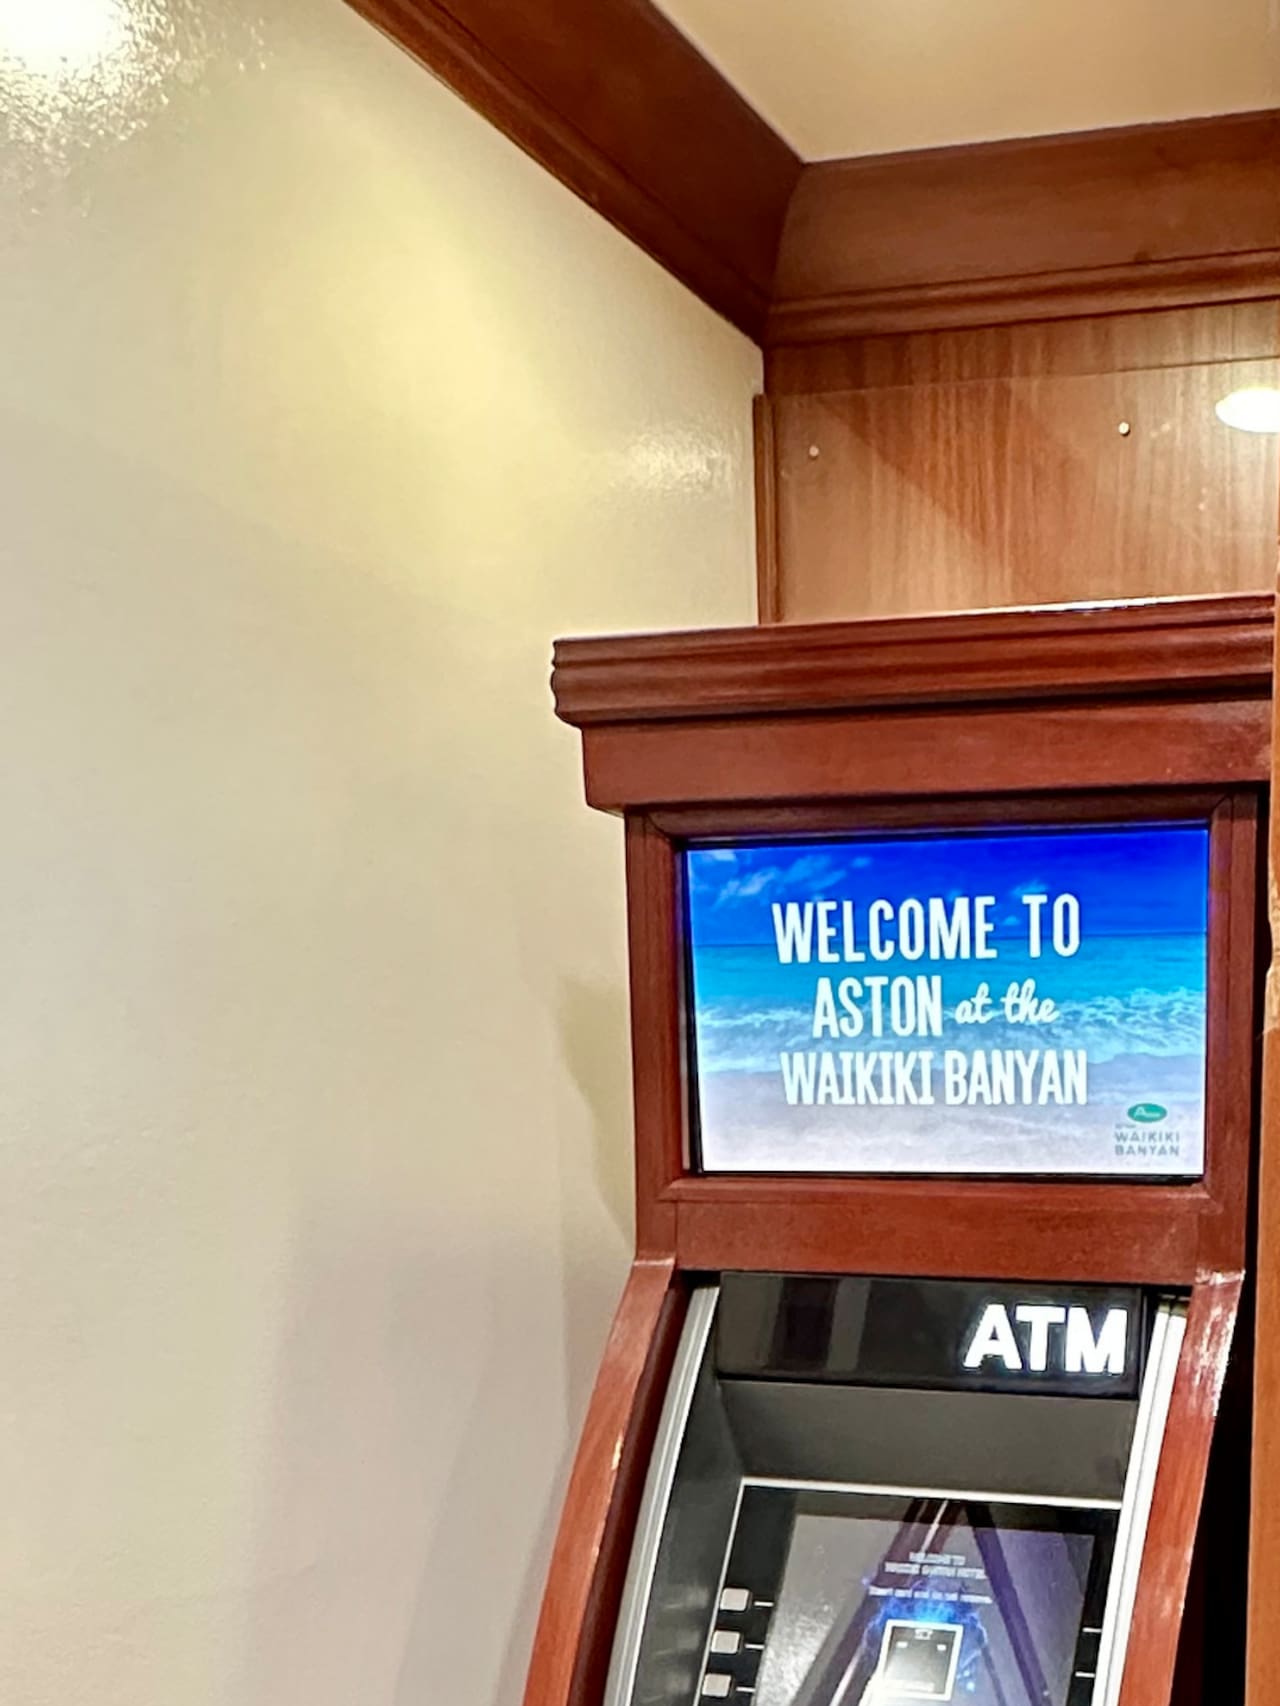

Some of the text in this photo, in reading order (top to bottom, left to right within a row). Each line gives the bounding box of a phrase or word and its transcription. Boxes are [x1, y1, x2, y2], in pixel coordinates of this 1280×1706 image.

[772, 893, 1079, 963] WELCOME TO
[812, 975, 1060, 1038] ASTON at the
[780, 1049, 1088, 1105] WAIKIKI BANYAN
[1114, 1131, 1180, 1142] WAIKIKI
[1115, 1144, 1179, 1157] BANYAN
[963, 1304, 1128, 1374] ATM
